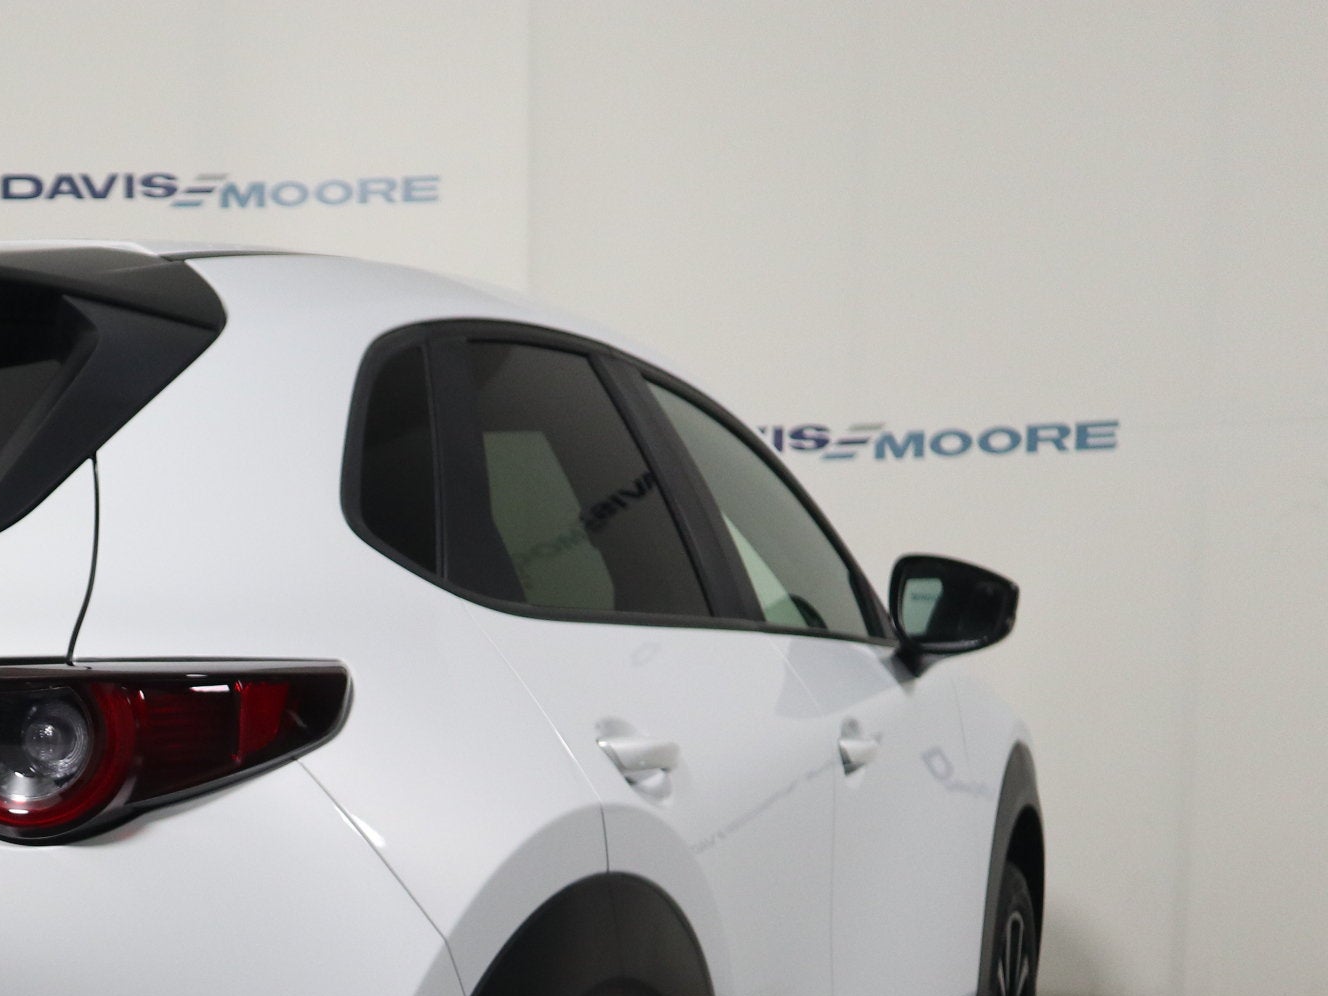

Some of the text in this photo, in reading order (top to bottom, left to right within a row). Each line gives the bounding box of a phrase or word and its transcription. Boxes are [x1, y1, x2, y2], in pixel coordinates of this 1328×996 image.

[0, 172, 441, 209] DAVIS MOORE
[873, 419, 1120, 461] MOORE
